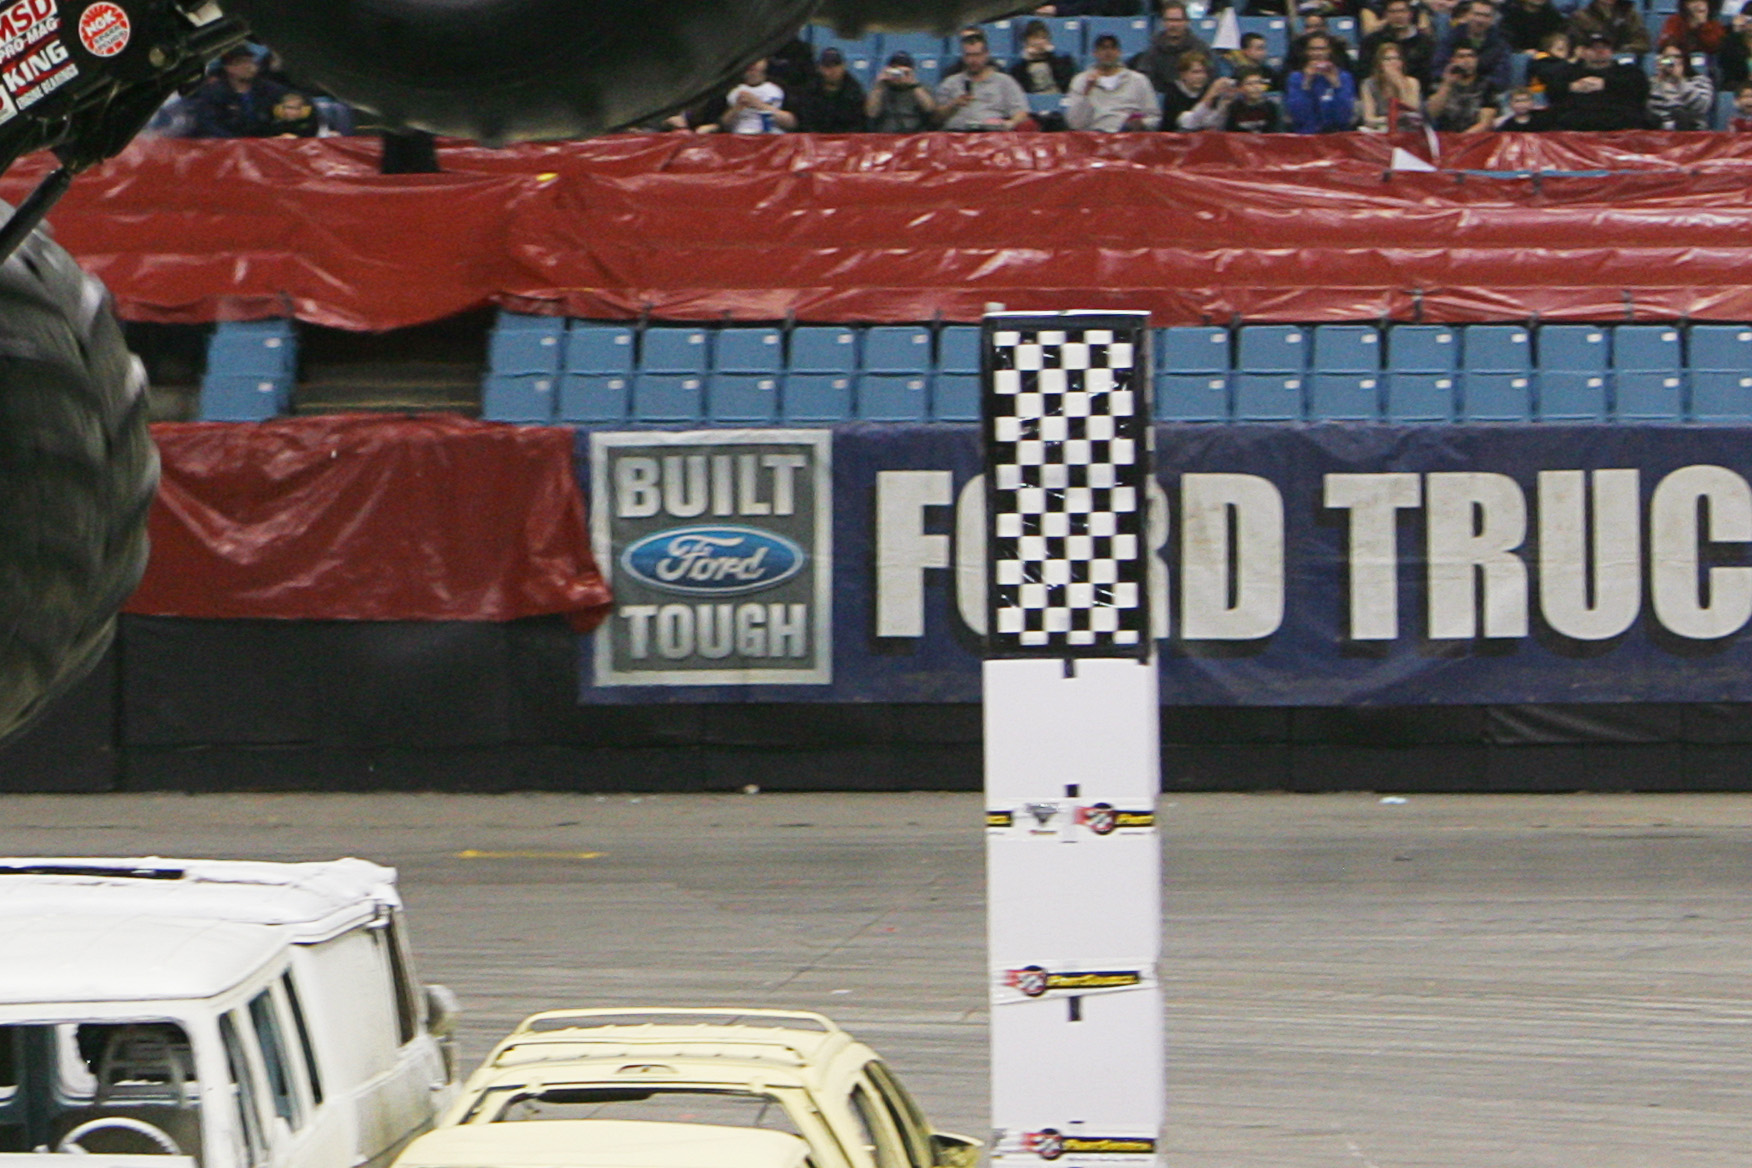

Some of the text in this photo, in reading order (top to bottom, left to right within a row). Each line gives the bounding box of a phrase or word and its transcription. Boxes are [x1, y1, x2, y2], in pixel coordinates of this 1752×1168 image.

[84, 9, 117, 37] NGK
[2, 39, 69, 93] KING
[614, 453, 808, 519] BUILT
[655, 533, 771, 582] Ford
[875, 469, 1285, 641] FD
[618, 602, 808, 660] TOUGH
